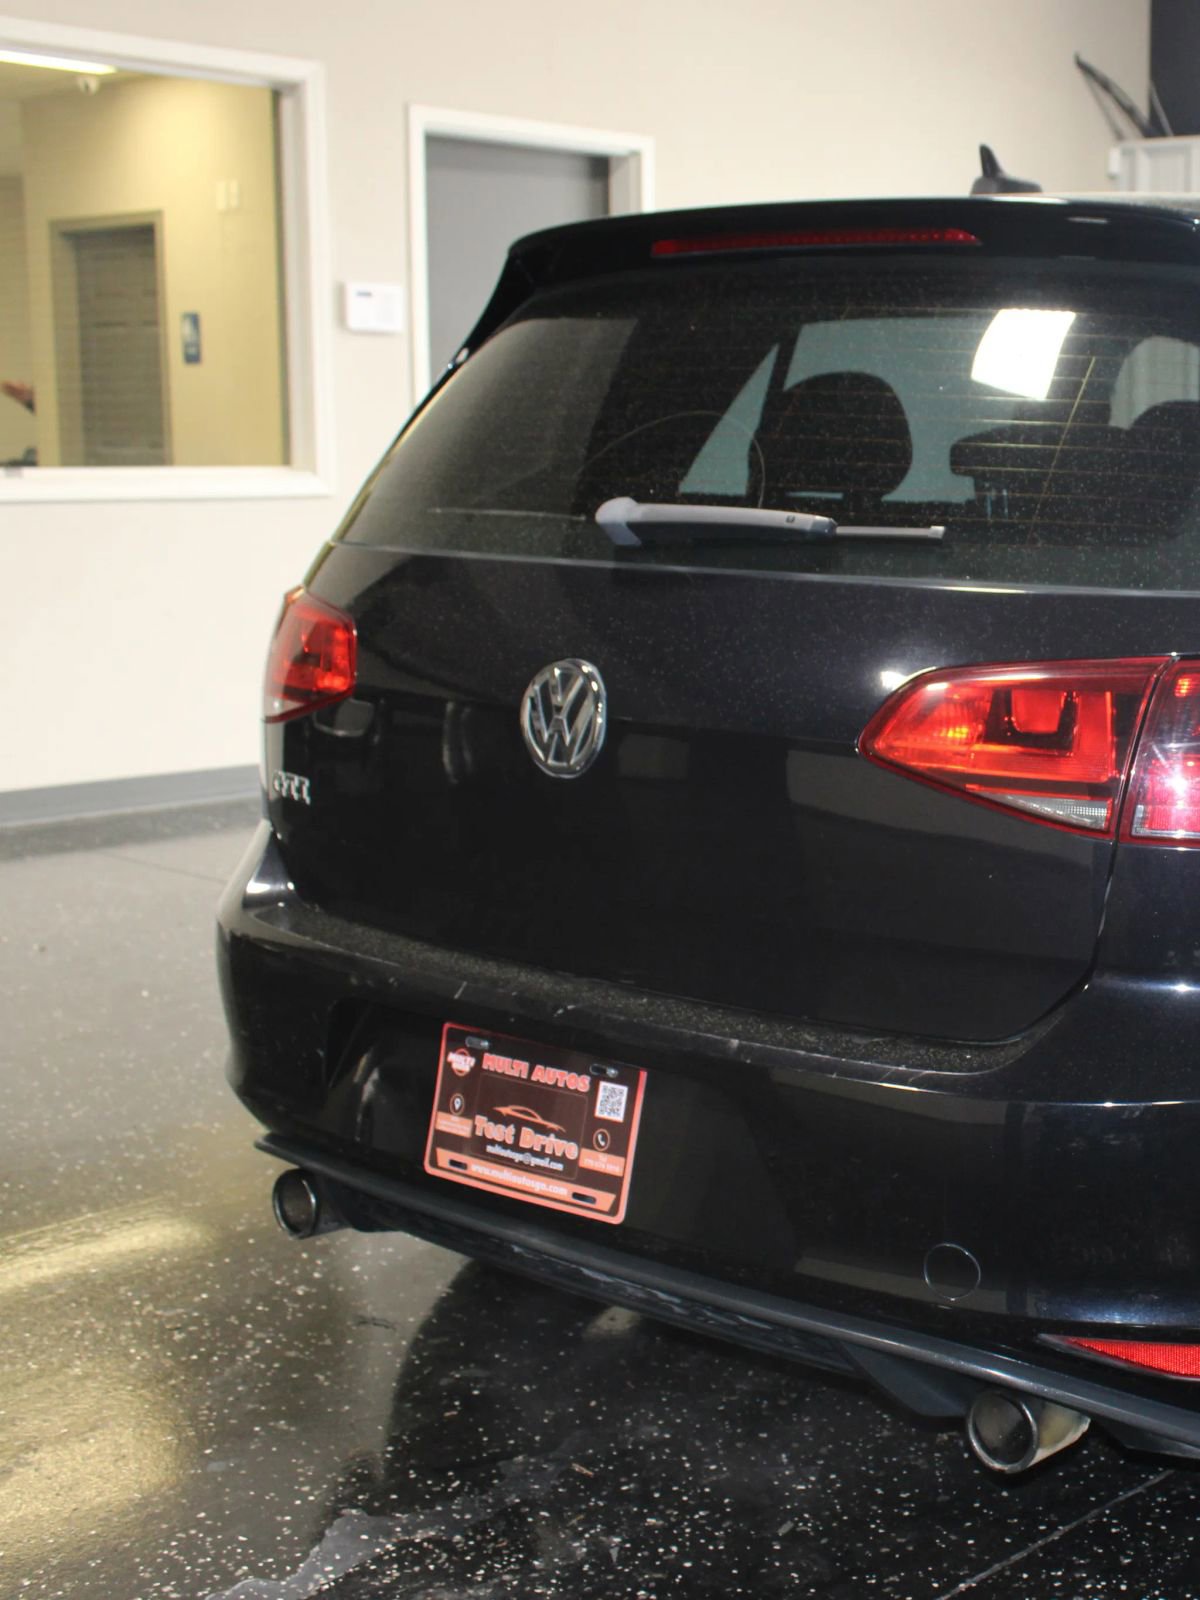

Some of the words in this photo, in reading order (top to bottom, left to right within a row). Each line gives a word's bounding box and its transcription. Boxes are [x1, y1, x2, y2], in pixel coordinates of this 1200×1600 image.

[482, 1053, 529, 1079] MULTI
[531, 1065, 591, 1093] AUTOS
[474, 1115, 516, 1145] Test
[519, 1126, 579, 1160] Drive
